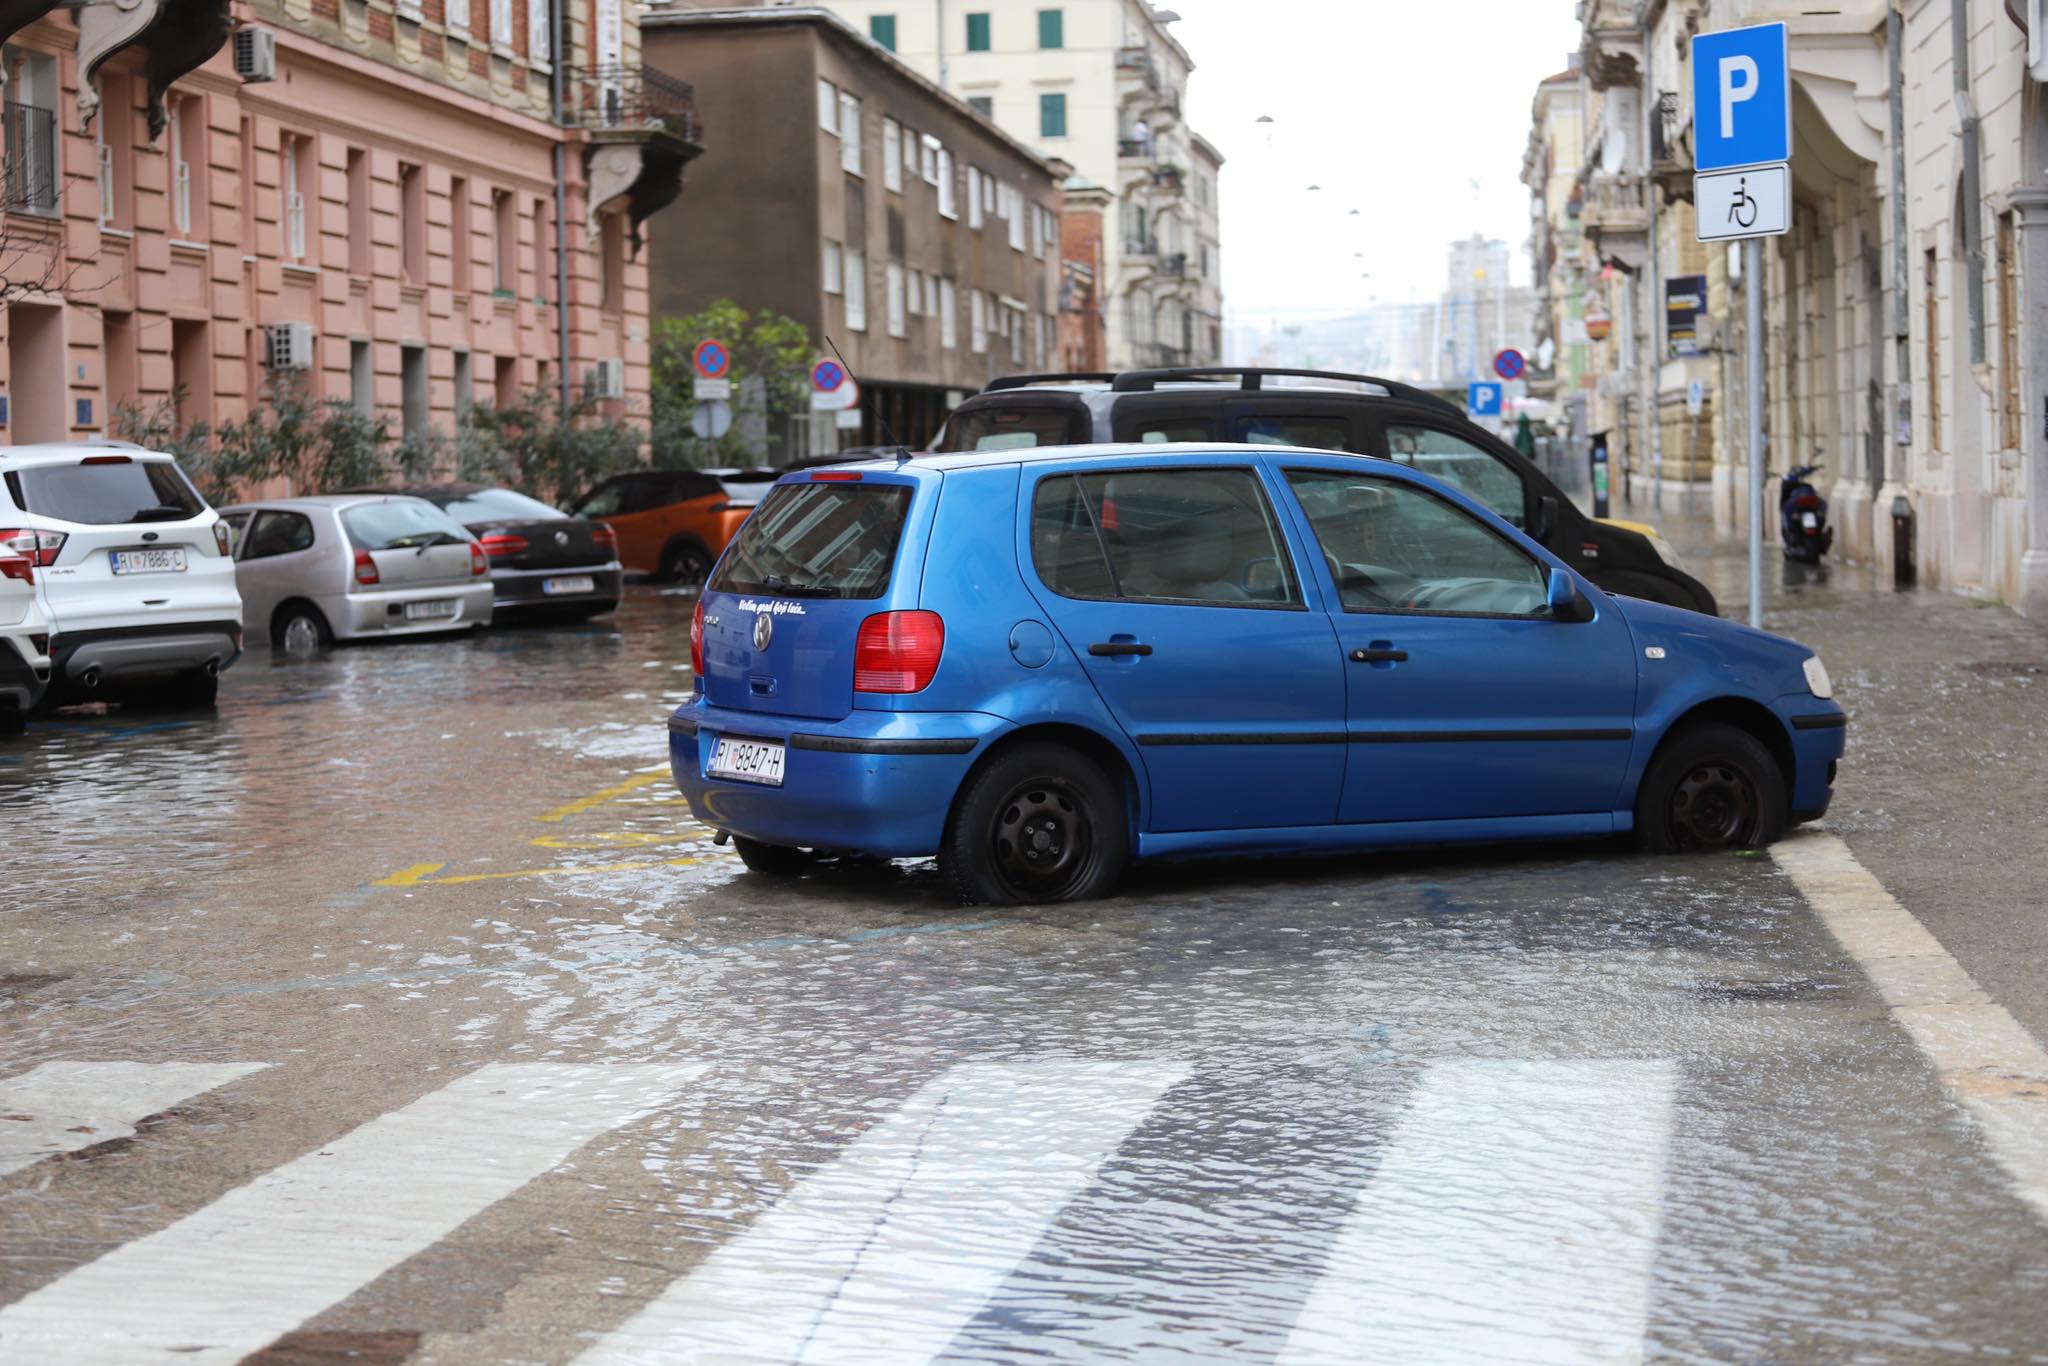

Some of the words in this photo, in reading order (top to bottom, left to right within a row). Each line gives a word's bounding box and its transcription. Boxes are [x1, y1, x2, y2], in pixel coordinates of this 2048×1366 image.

[1719, 54, 1759, 139] P
[1476, 386, 1495, 410] P
[120, 552, 132, 569] RI
[716, 742, 731, 769] RI
